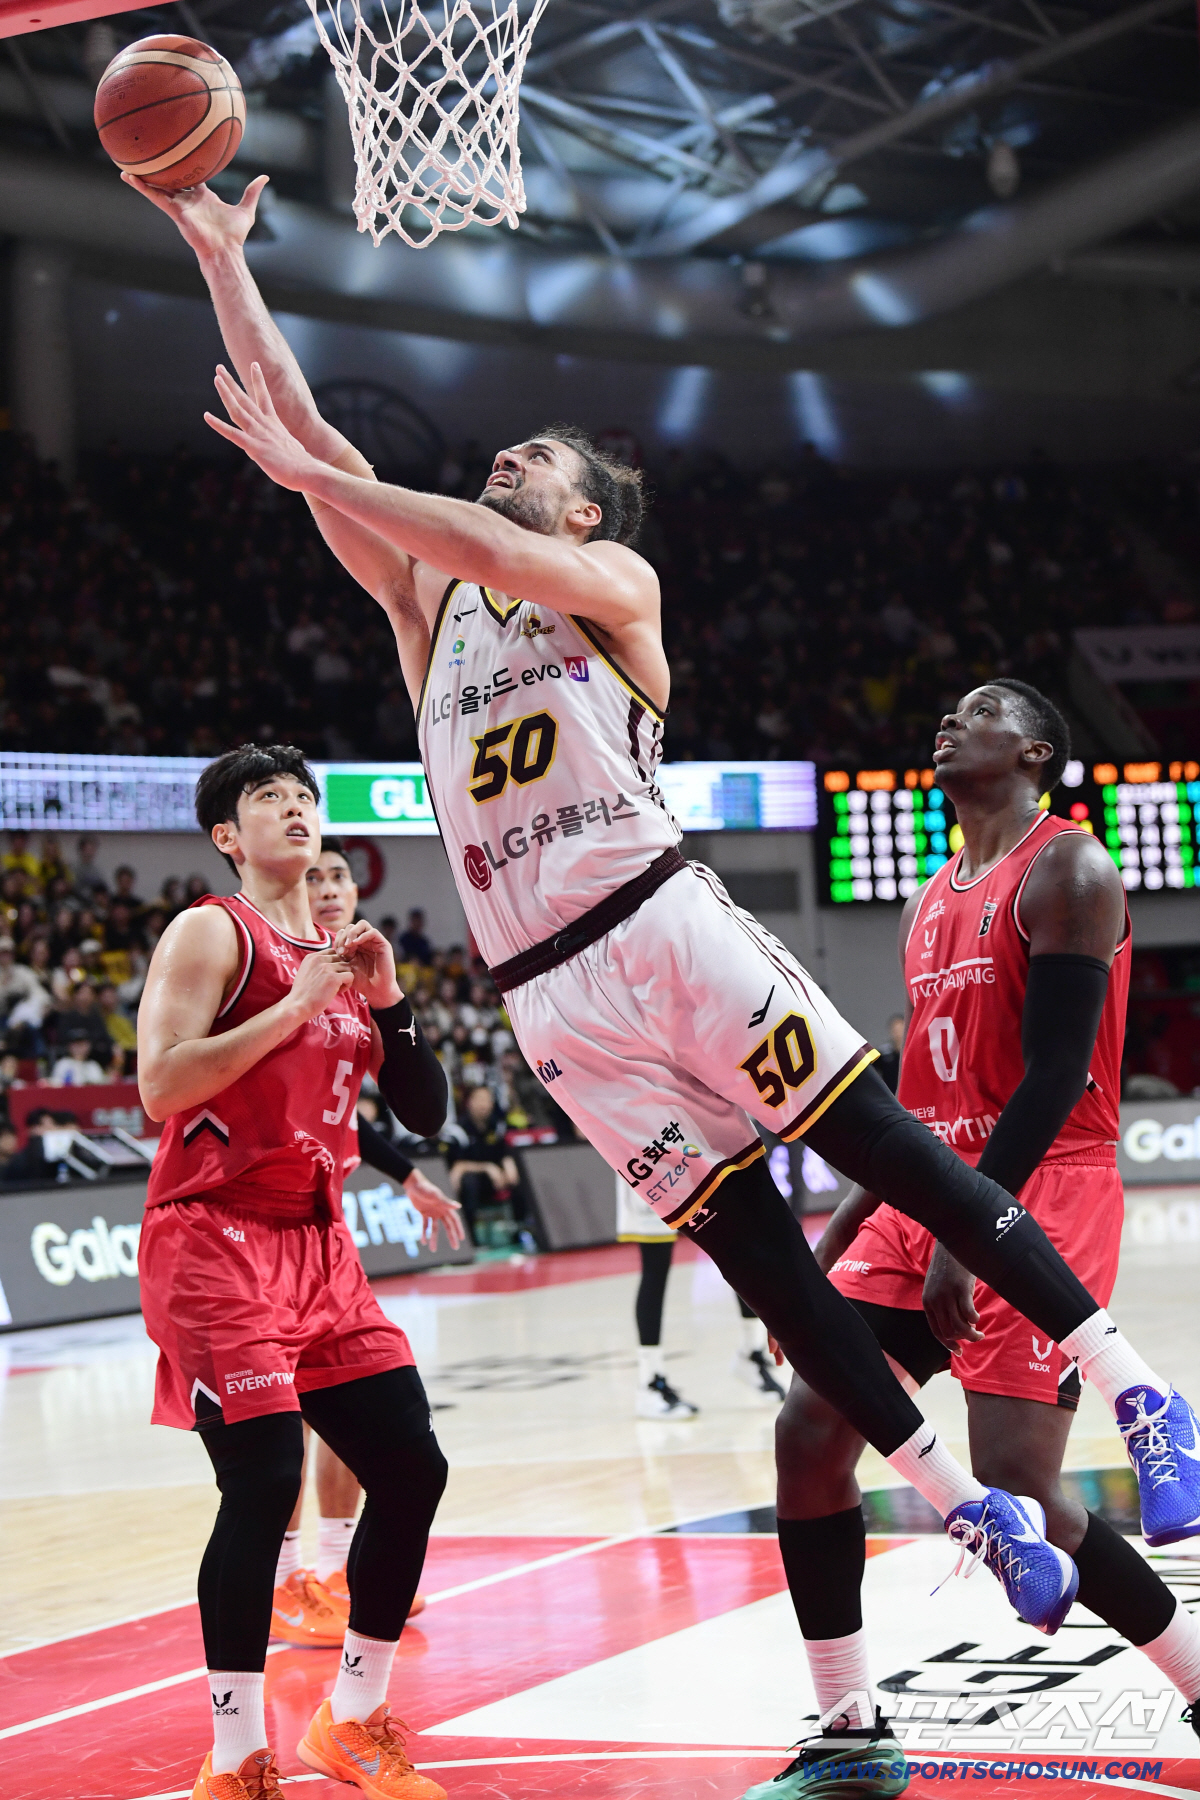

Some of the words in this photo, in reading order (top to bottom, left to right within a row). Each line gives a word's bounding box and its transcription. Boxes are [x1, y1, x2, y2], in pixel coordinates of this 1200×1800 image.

[432, 693, 452, 726] LG
[521, 664, 562, 686] evo
[567, 660, 588, 678] AI
[465, 708, 559, 806] 50
[482, 792, 641, 871] LG유플러스
[536, 1058, 563, 1084] KBL
[735, 1009, 818, 1111] 50
[928, 1016, 960, 1083] 0
[322, 1059, 354, 1126] 5
[617, 1120, 685, 1189] LG화학
[225, 1371, 296, 1395] EVERY'TIM
[1029, 1361, 1050, 1373] VEXX
